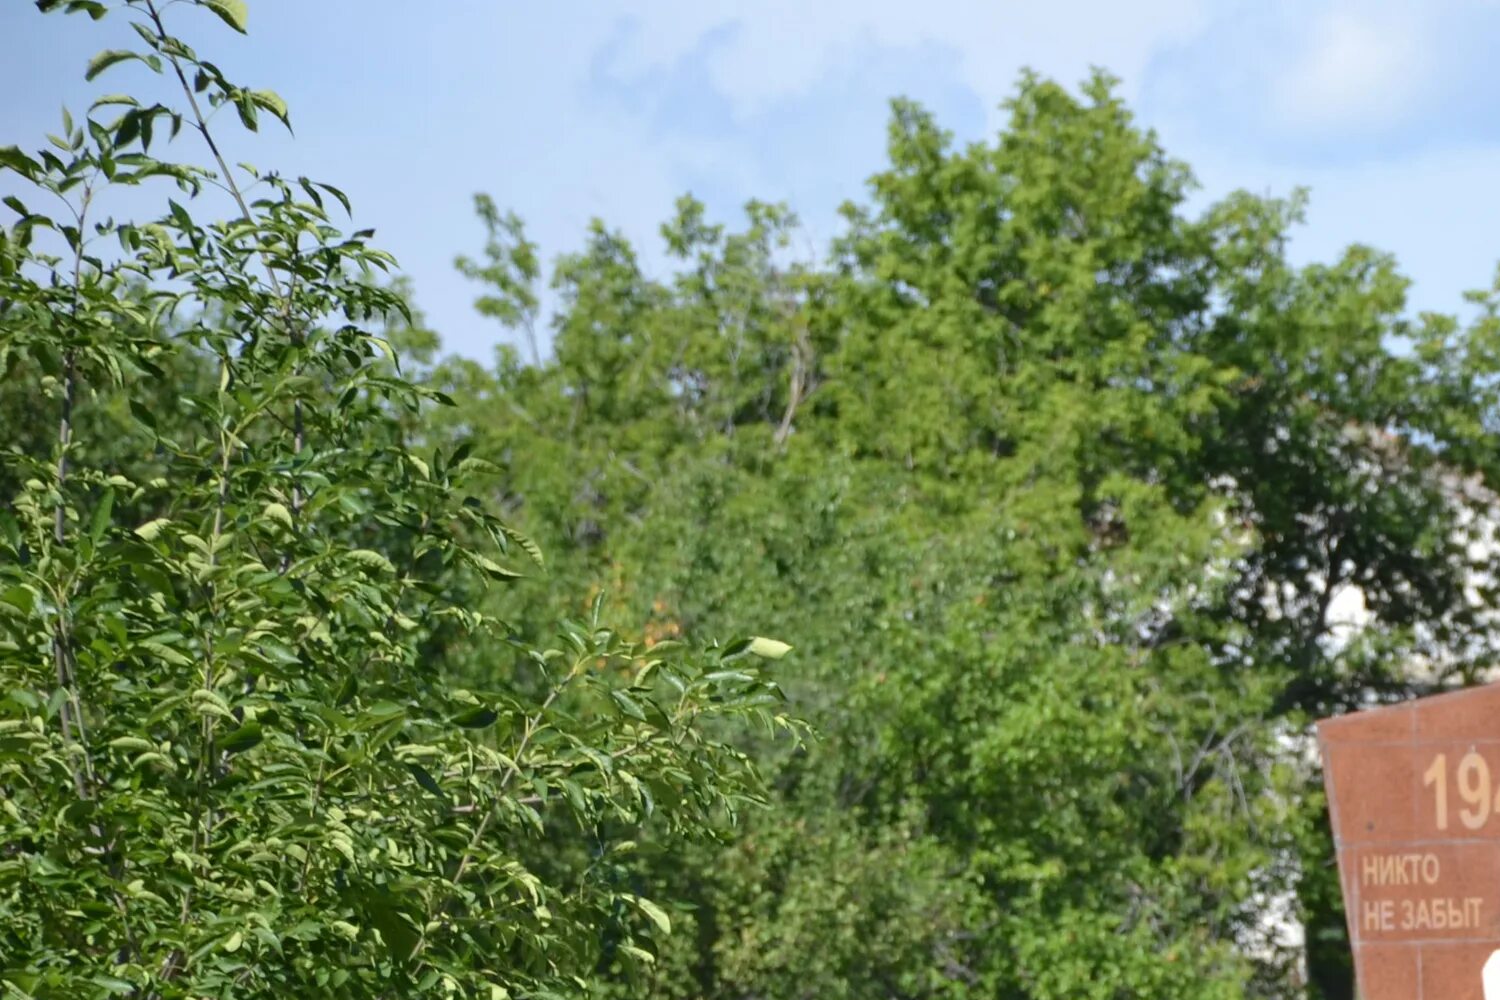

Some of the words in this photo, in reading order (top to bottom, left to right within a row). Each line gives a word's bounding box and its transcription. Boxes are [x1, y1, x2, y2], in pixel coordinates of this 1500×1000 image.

[1363, 854, 1440, 886] НИКТО
[1364, 900, 1395, 930] НЕ
[1401, 897, 1482, 929] ЗАБЫТ
